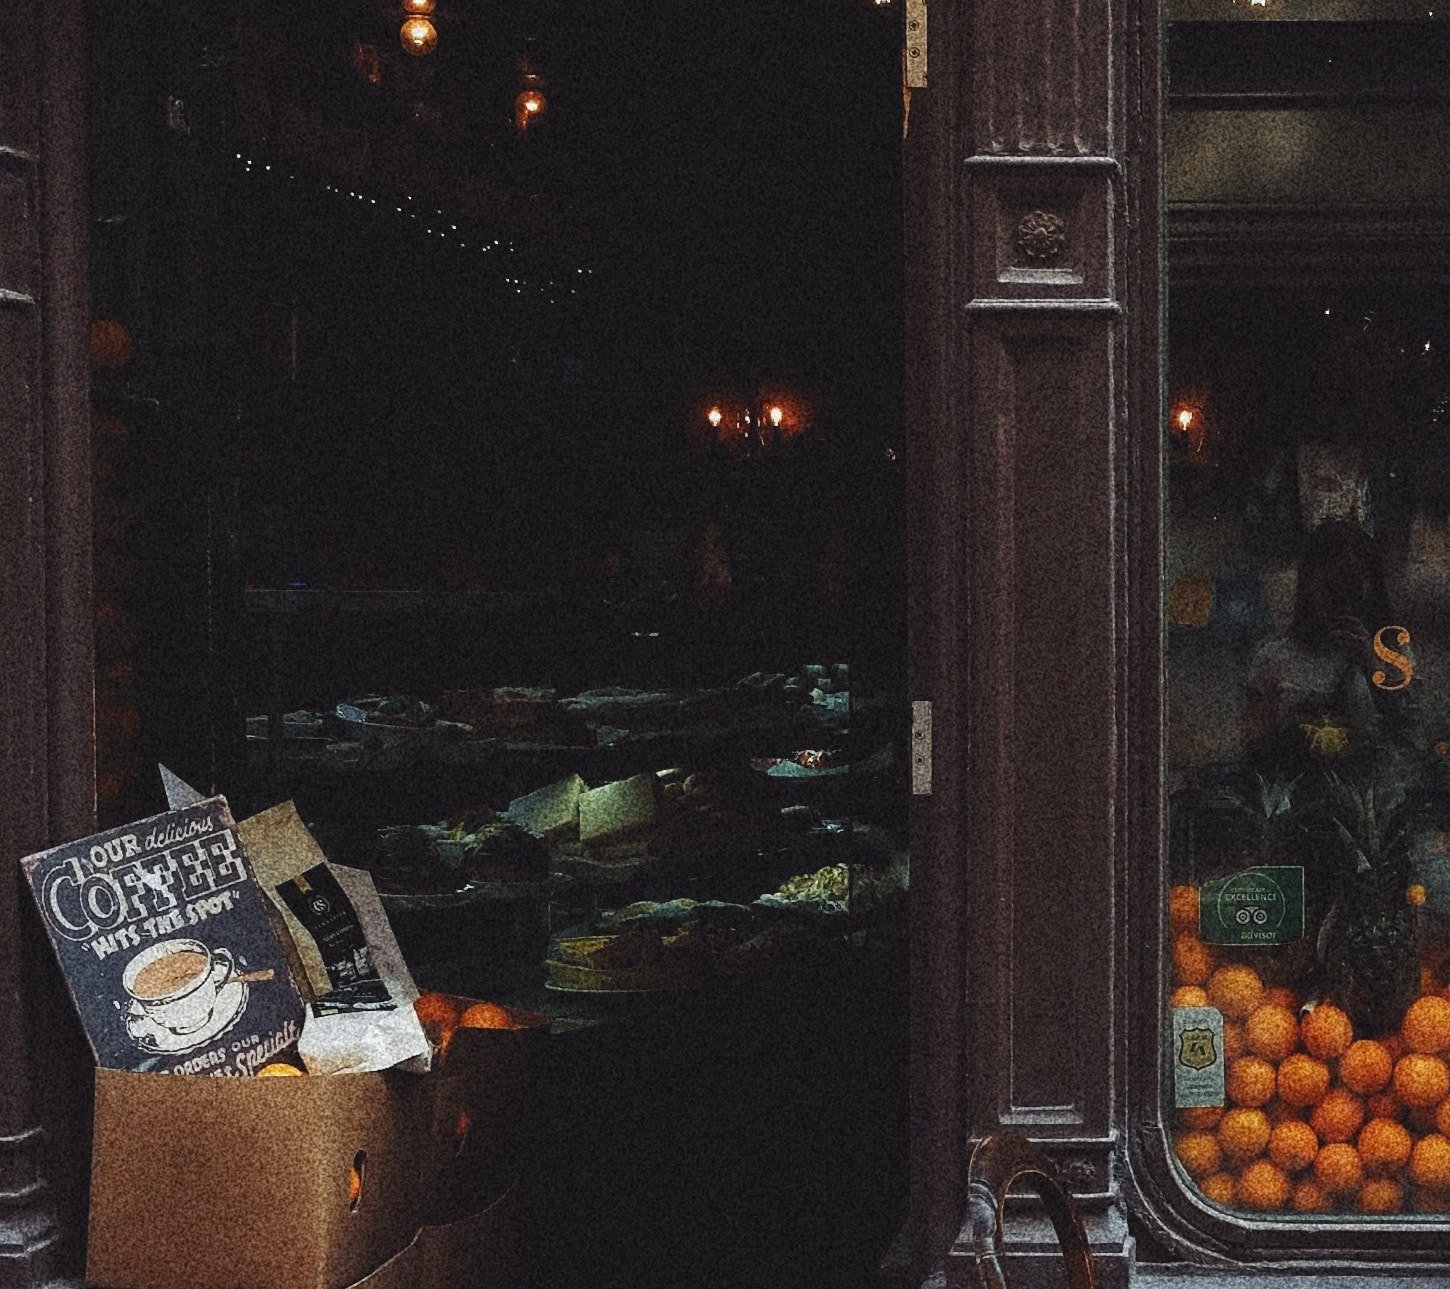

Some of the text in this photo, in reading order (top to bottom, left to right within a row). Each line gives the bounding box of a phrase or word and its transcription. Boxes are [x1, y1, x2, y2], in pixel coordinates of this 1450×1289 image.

[90, 815, 214, 868] OUR delicious
[41, 828, 248, 942] COFFEE
[143, 908, 185, 939] THE
[173, 1047, 227, 1076] ORDERS
[231, 1034, 260, 1052] OUR
